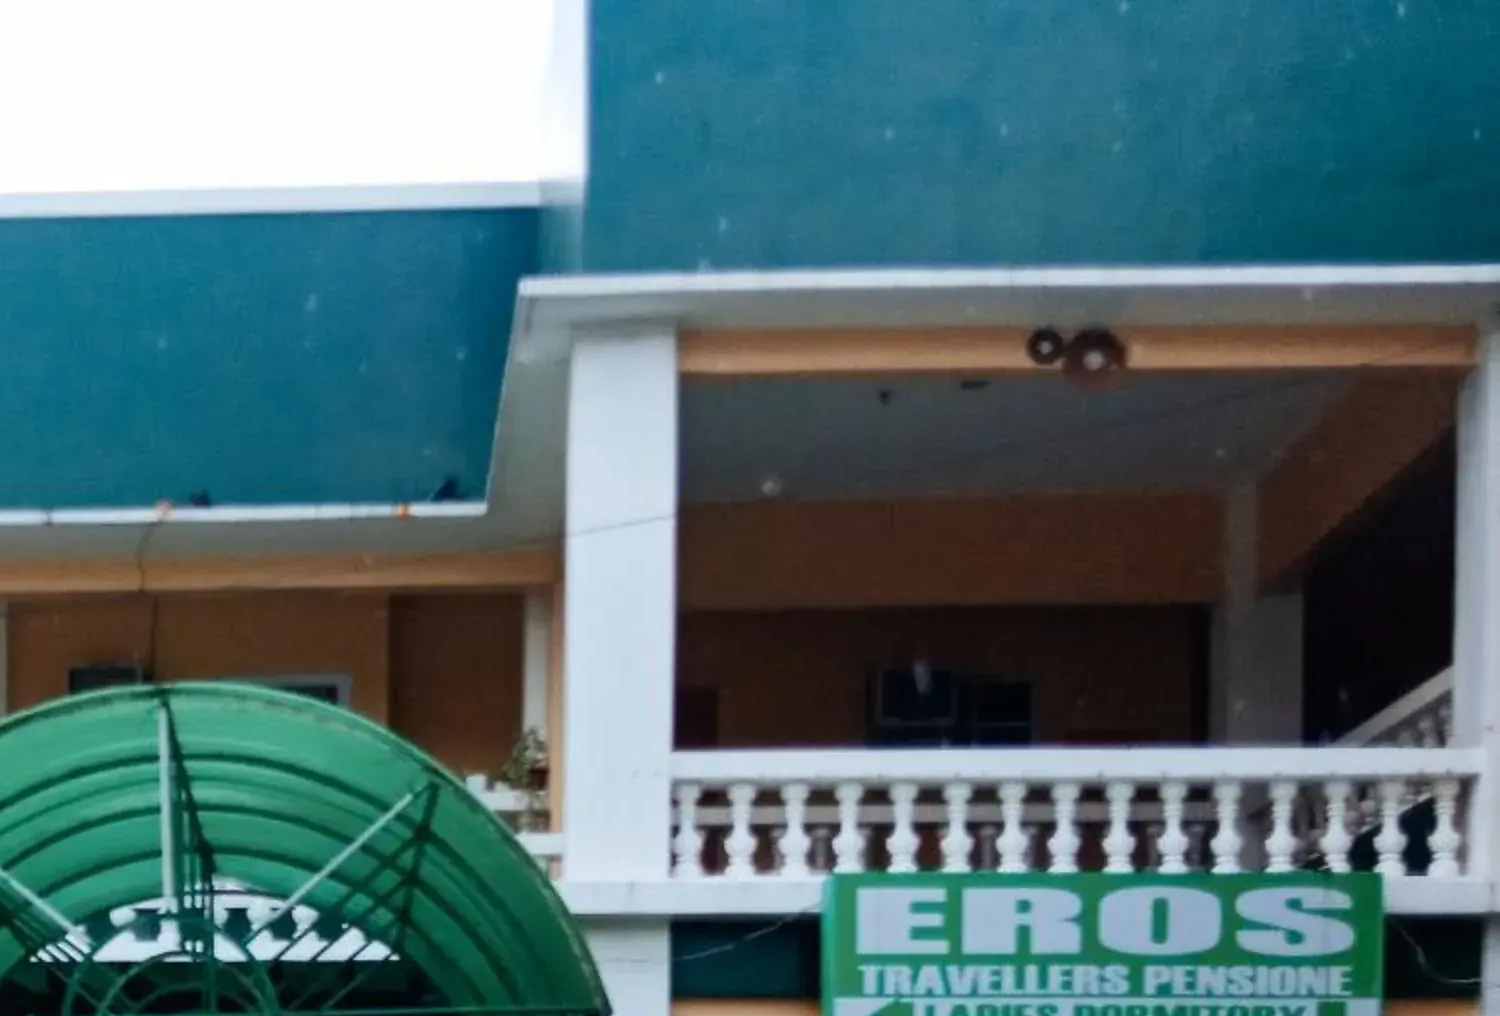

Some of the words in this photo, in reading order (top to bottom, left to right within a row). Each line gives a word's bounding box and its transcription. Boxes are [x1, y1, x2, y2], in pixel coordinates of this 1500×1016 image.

[855, 886, 1356, 957] EROS
[858, 965, 1129, 997] TRAVELLERS
[1145, 965, 1353, 996] PENSIONE
